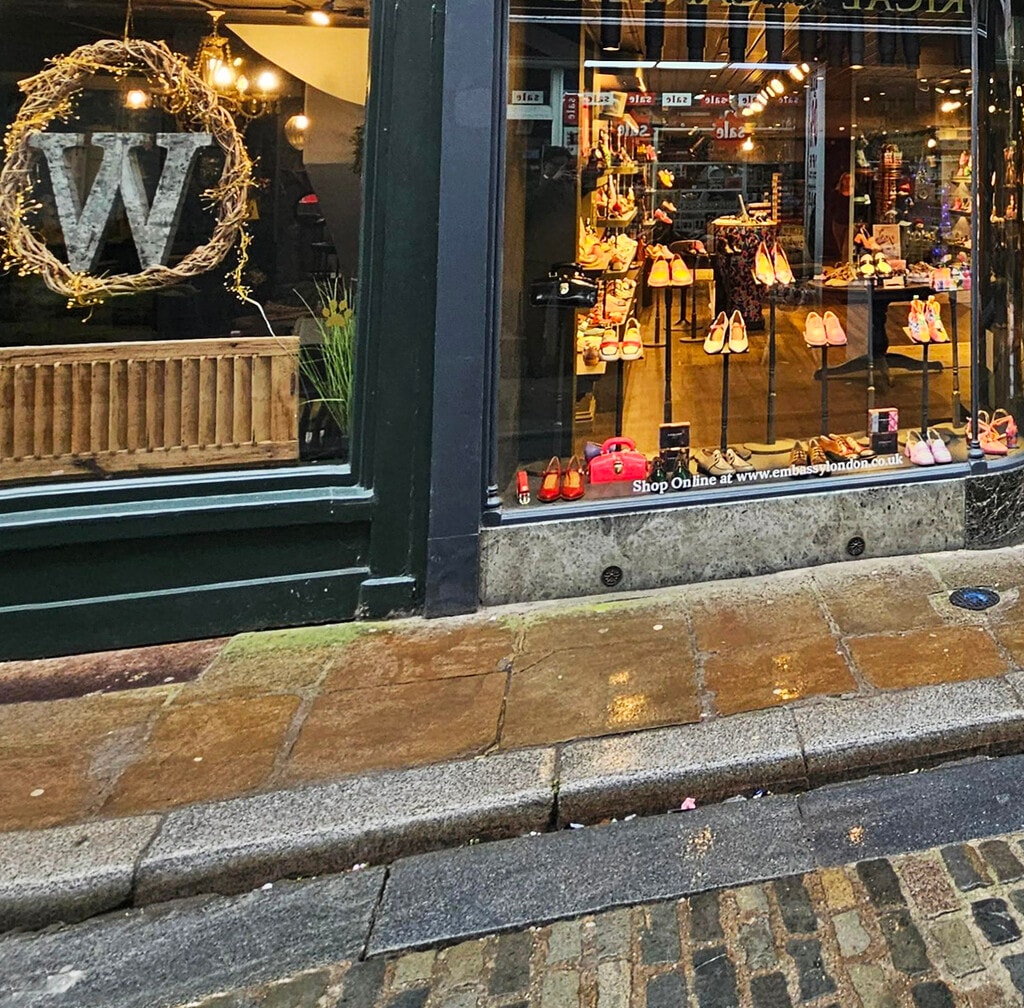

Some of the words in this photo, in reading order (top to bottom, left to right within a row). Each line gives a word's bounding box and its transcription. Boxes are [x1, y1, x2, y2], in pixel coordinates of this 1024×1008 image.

[27, 132, 214, 274] W
[632, 478, 668, 495] Shop
[671, 476, 717, 491] Online
[720, 473, 734, 485] at
[736, 453, 904, 482] www.embassylondon.co.uk
